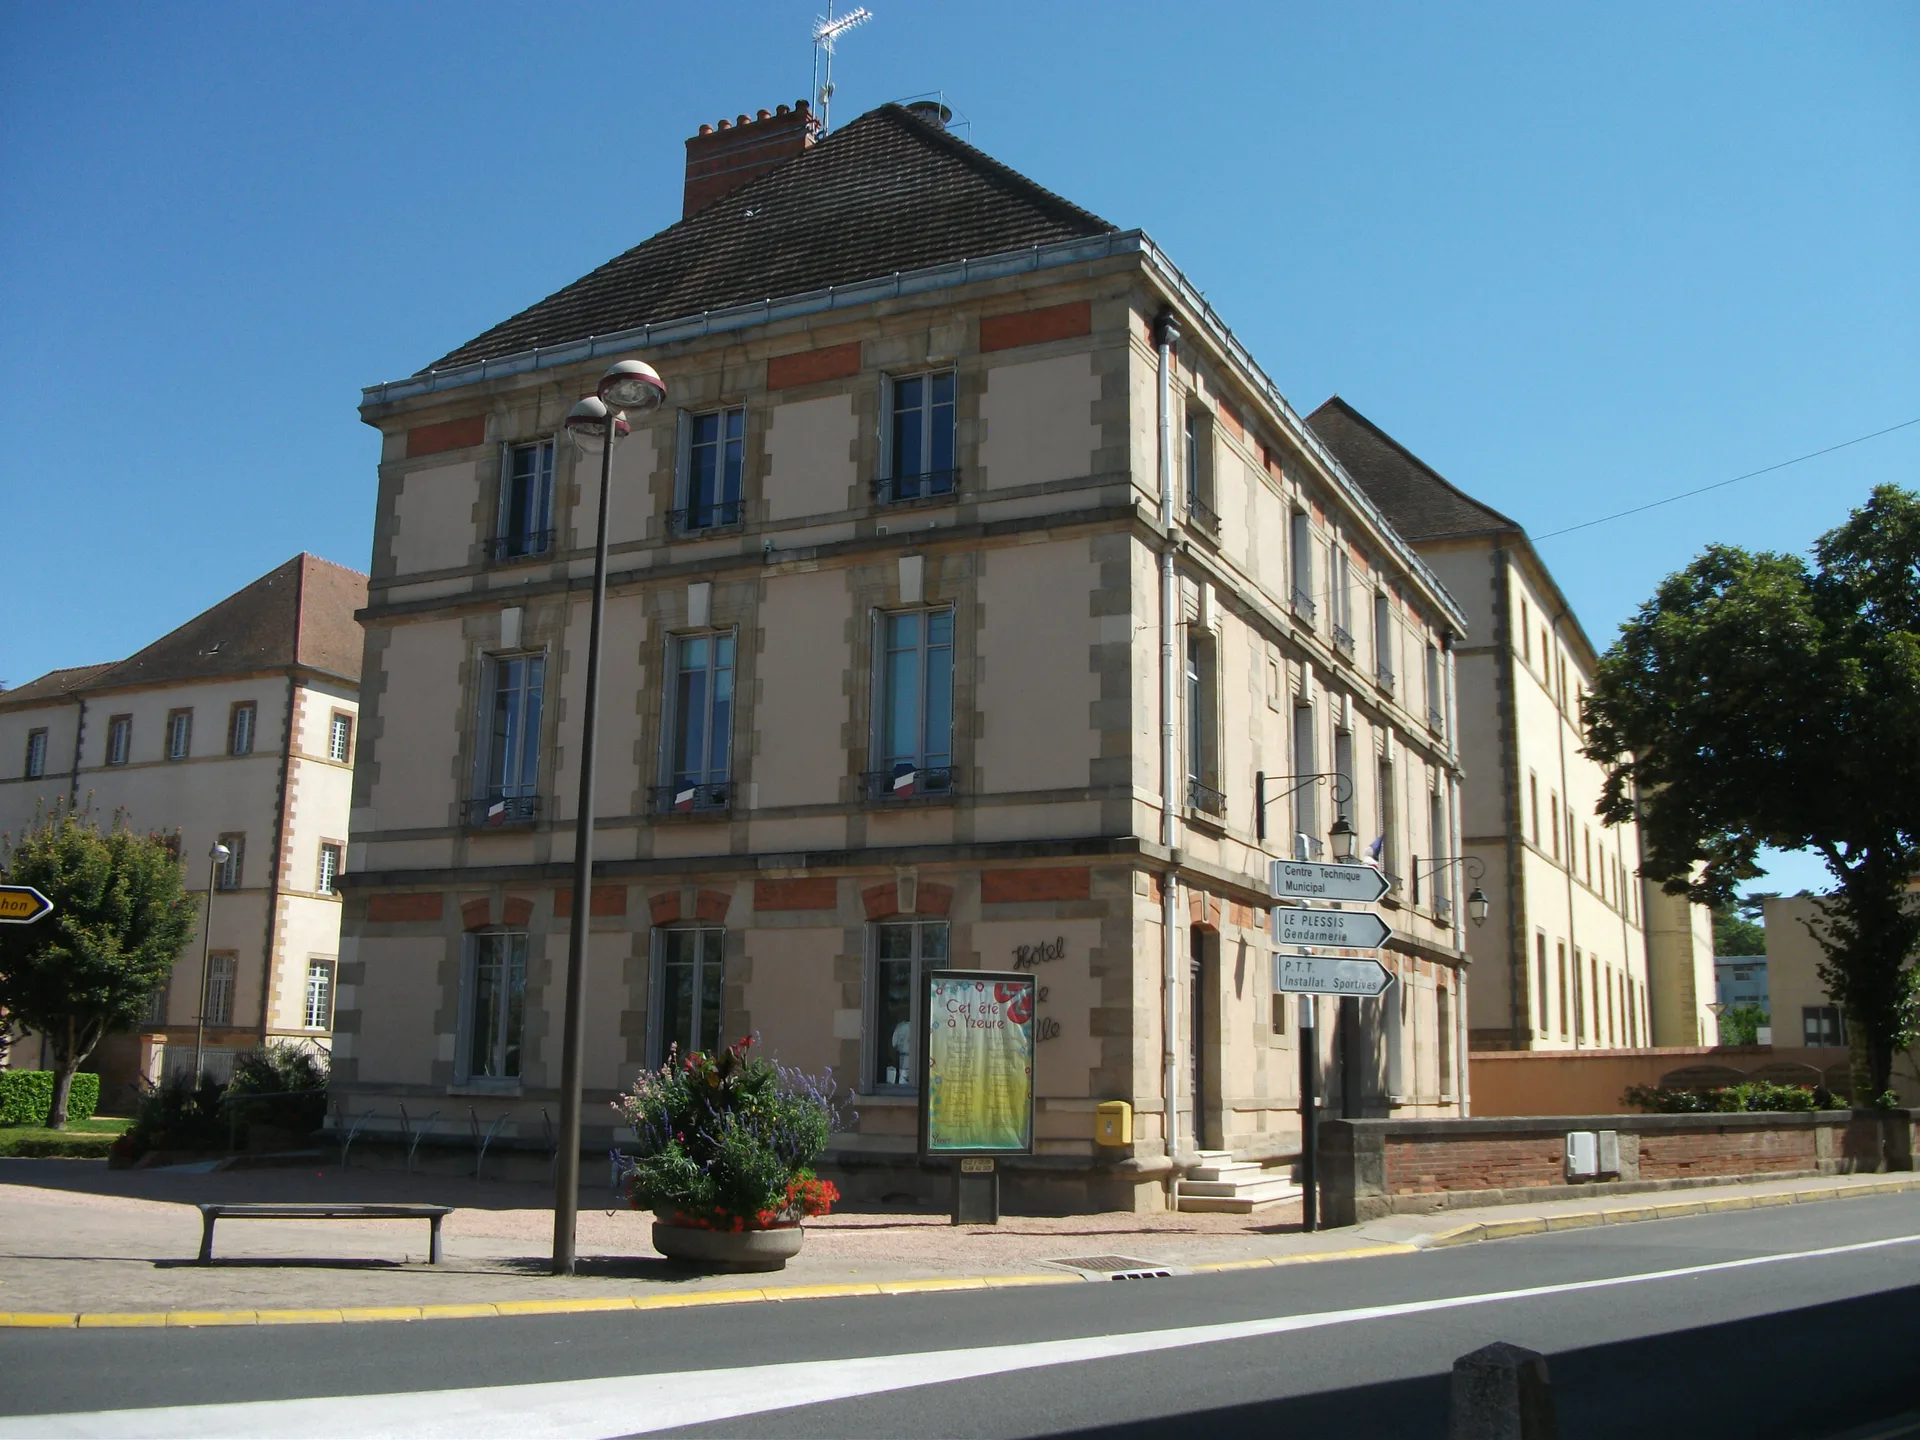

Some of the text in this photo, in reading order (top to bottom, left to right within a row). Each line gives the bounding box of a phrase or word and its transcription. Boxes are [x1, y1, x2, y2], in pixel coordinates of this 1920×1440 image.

[1284, 865, 1361, 882] Centre Technique
[1285, 881, 1325, 895] Municipal
[1284, 914, 1344, 928] LE PLESSIS
[1284, 929, 1348, 942] Gendarmerie
[1012, 936, 1065, 970] Hôtel
[1284, 961, 1316, 973] P.T.T.
[1284, 976, 1377, 991] Installat. Sportives
[1037, 986, 1049, 1004] e
[946, 998, 999, 1015] Cet été
[947, 1014, 1005, 1029] à Yzeure
[1036, 1017, 1061, 1043] lle
